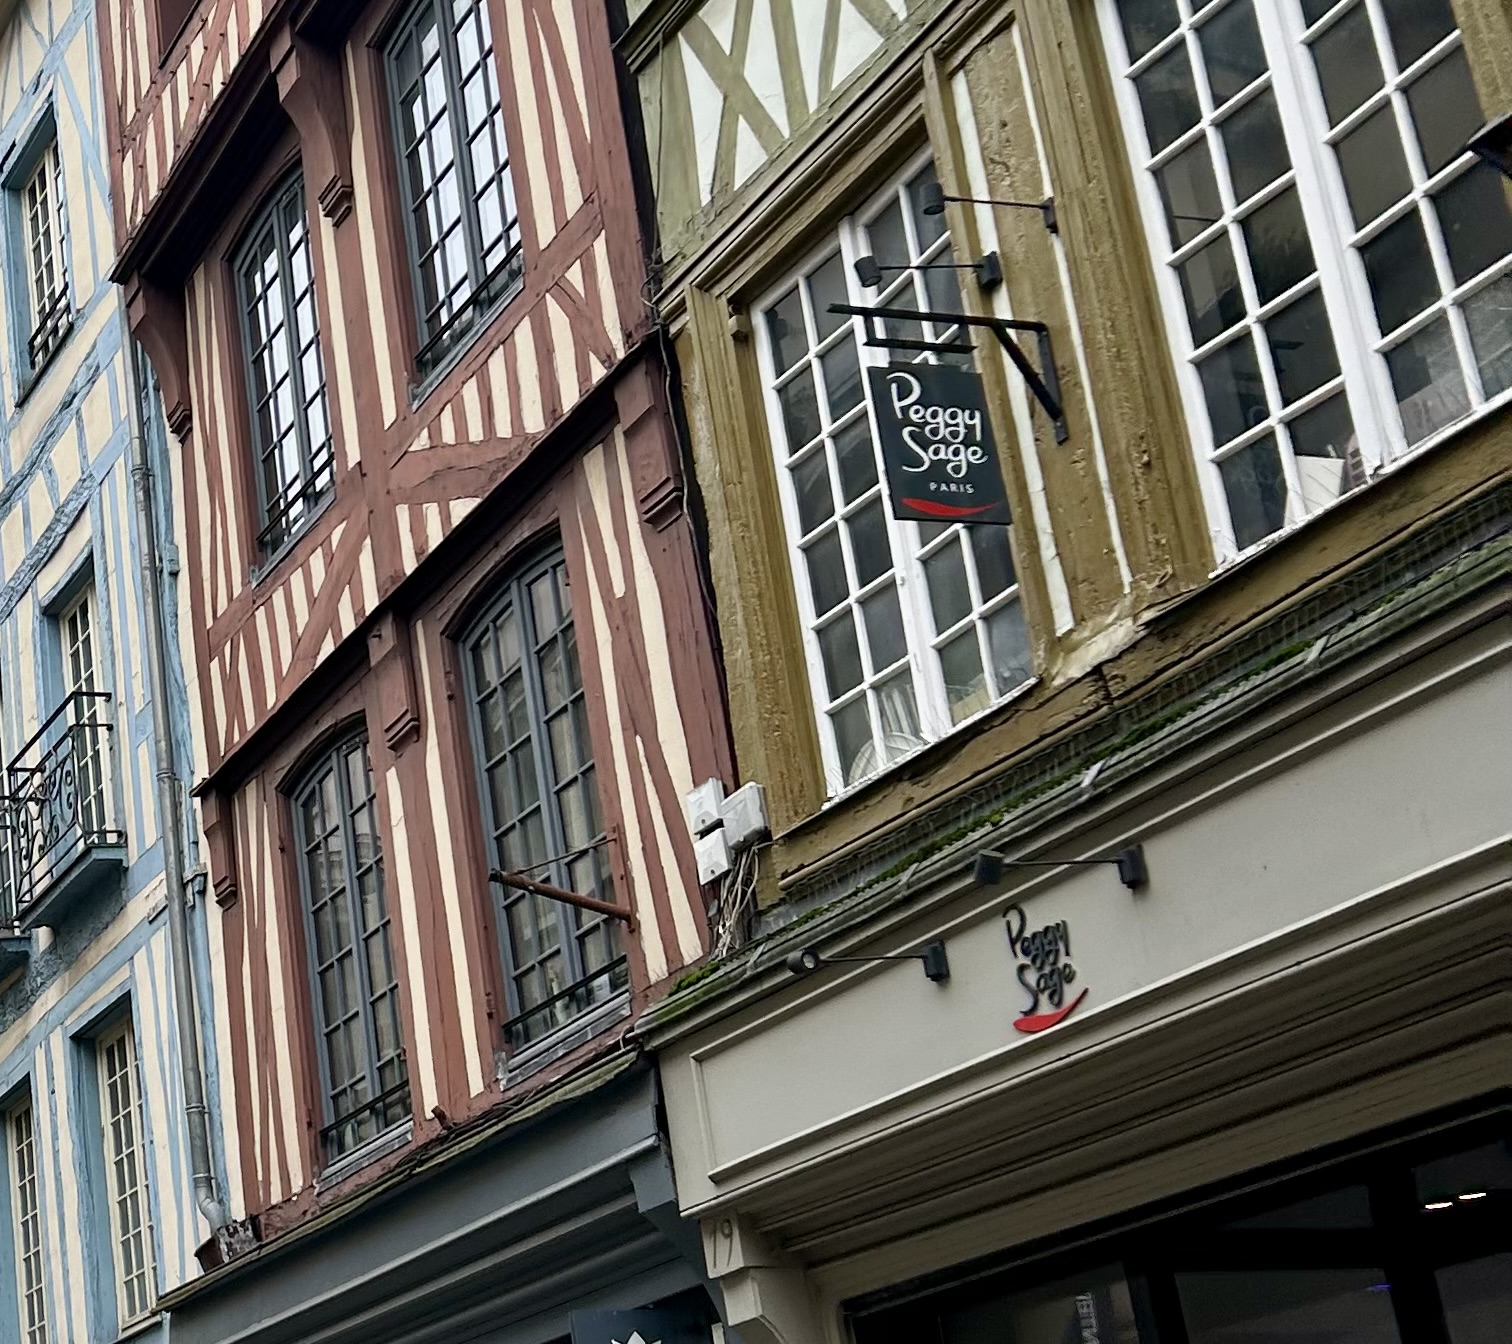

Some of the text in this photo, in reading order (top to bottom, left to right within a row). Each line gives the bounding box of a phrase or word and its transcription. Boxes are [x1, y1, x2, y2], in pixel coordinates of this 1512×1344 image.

[886, 371, 982, 443] Peggy
[901, 426, 988, 478] Sage
[929, 482, 975, 494] PARIS
[1002, 904, 1071, 972] Peggy
[1016, 962, 1076, 1017] Sage
